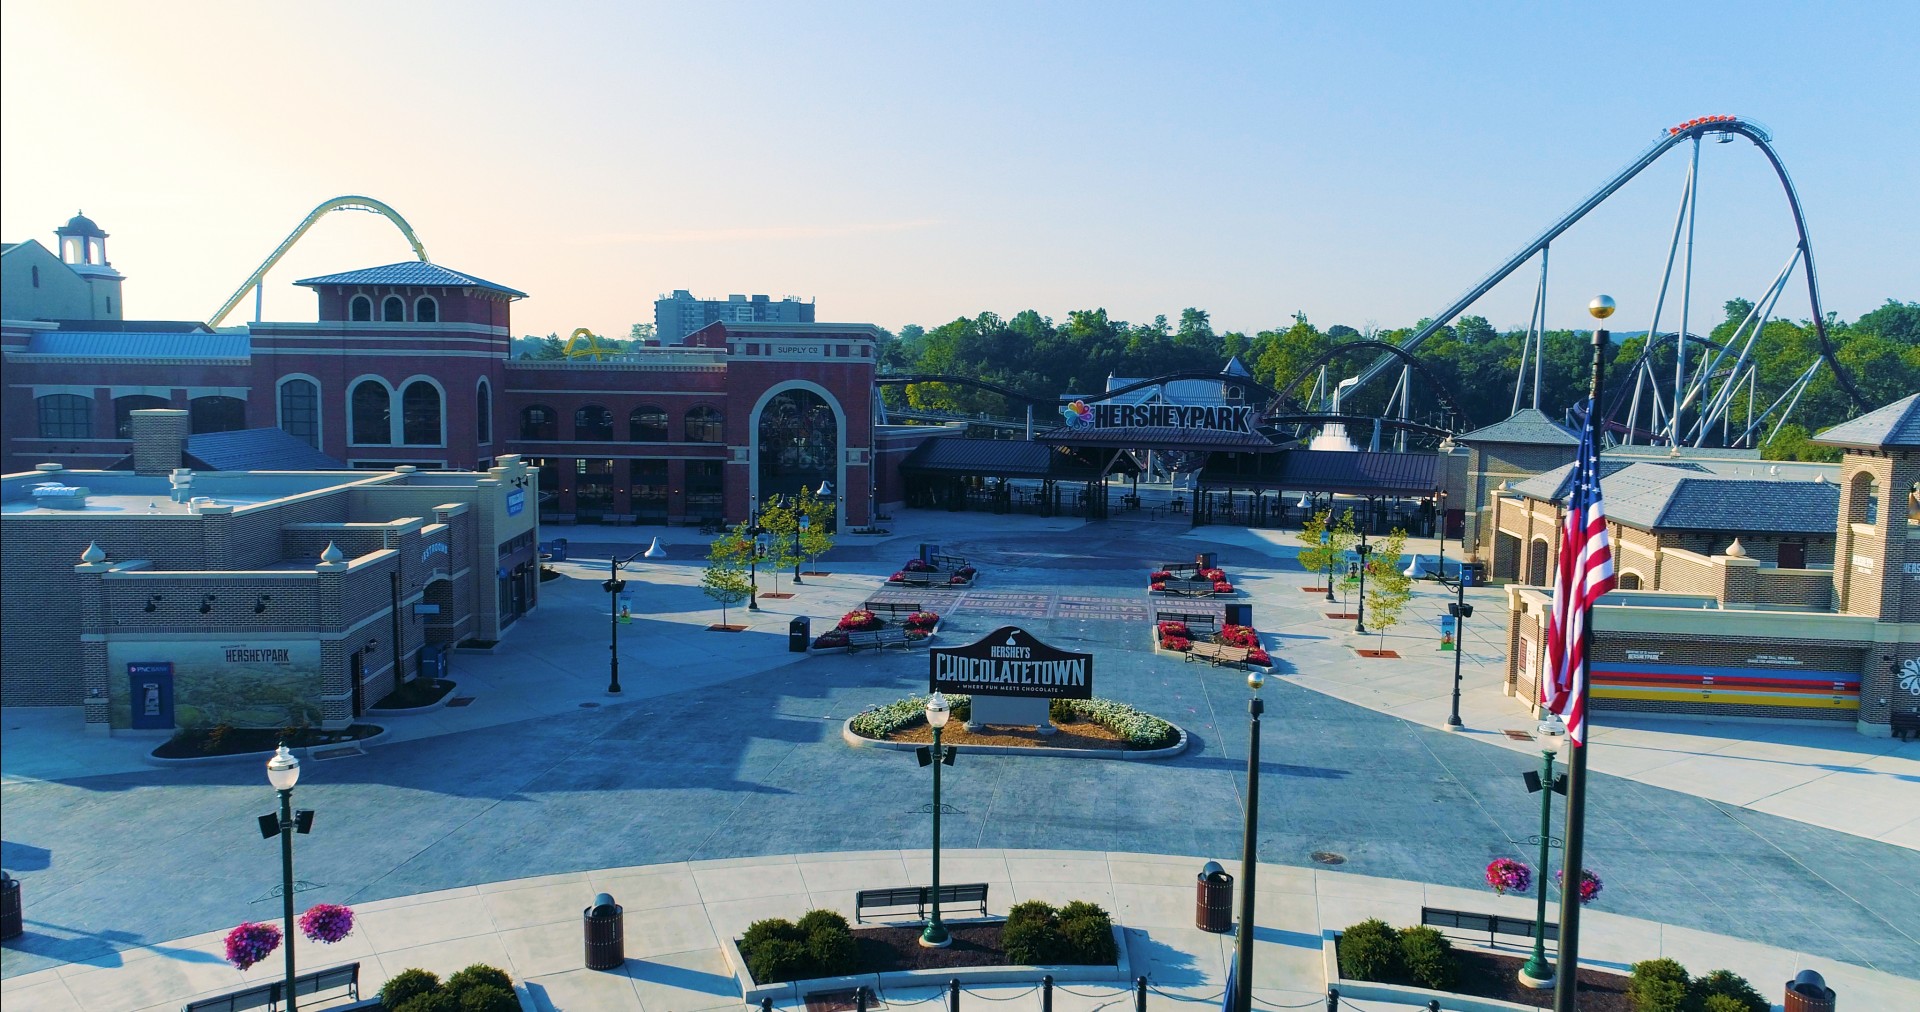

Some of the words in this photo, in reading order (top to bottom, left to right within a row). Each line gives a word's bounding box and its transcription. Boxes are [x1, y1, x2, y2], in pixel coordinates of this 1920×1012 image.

[777, 346, 807, 354] SUPPLY
[1094, 404, 1251, 434] HERSHEYPARK
[225, 649, 290, 662] HERSHEYPARK
[990, 645, 1031, 659] HERSHEY'S
[936, 652, 1086, 687] CHOCOLATETOWN
